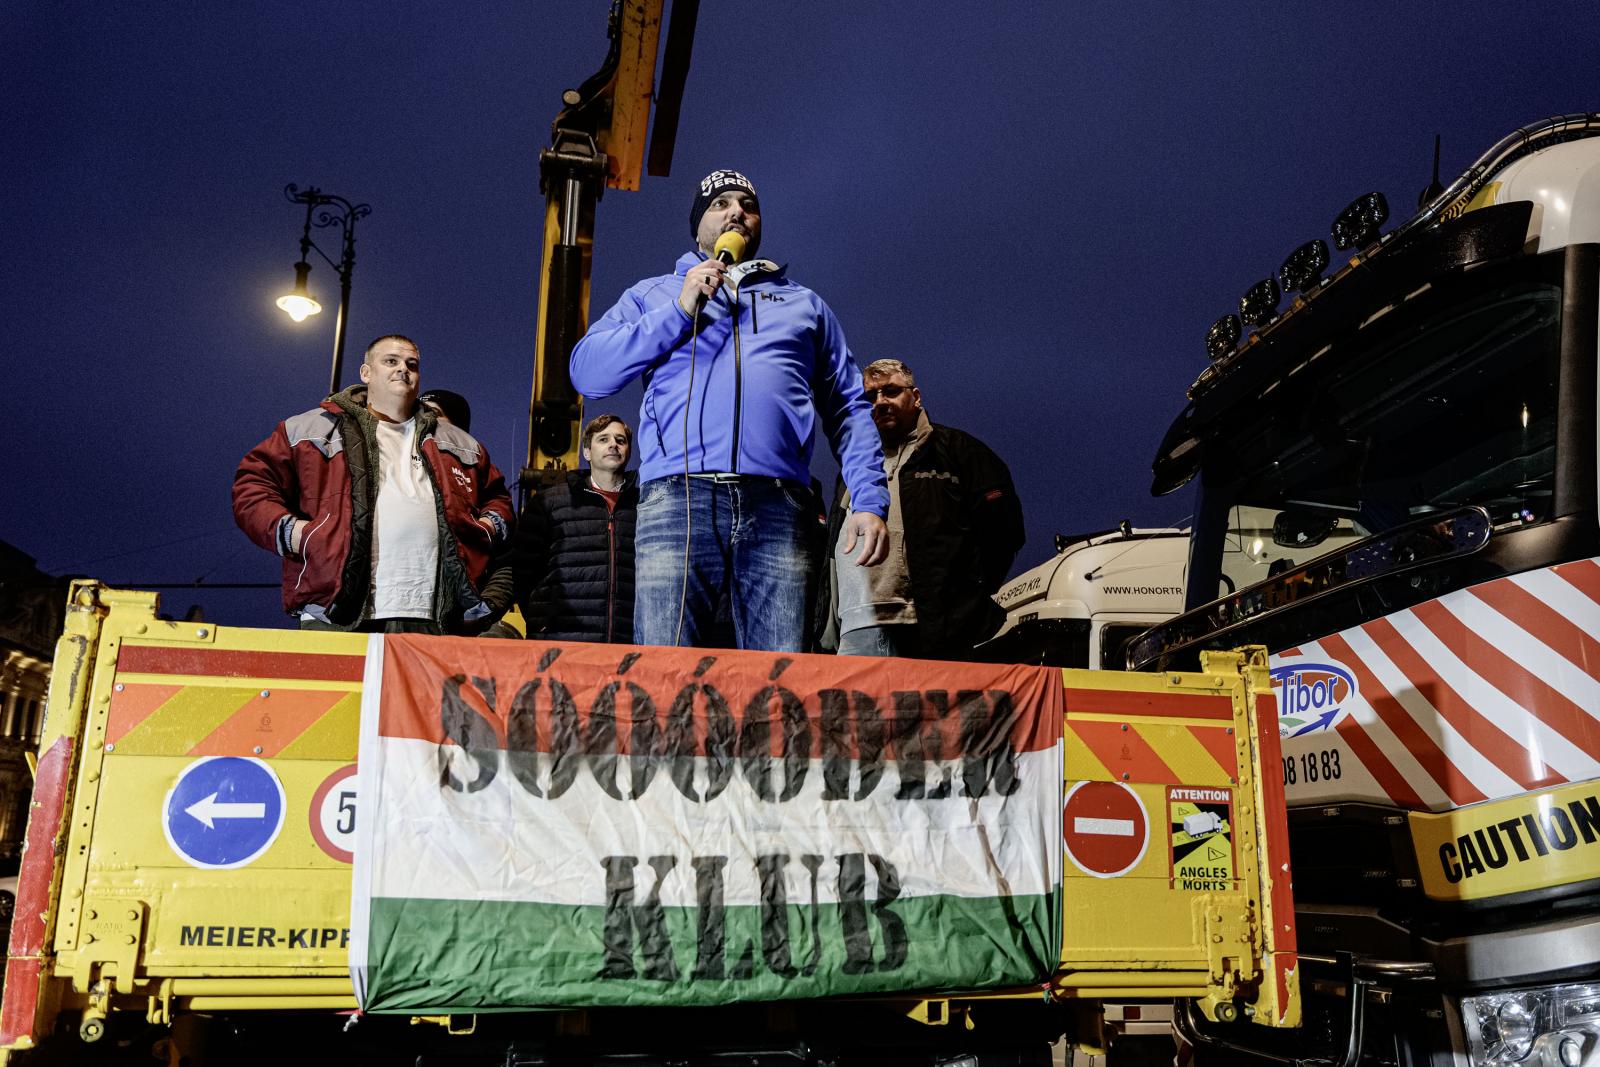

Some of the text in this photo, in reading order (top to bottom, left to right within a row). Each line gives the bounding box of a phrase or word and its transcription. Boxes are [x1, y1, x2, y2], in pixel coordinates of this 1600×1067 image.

[1276, 671, 1338, 715] Tibor
[1301, 752, 1319, 783] 18
[1321, 749, 1342, 781] 83
[1170, 788, 1230, 801] ATTENTION
[1438, 796, 1600, 884] CAUTION
[1180, 867, 1228, 878] ANGLES
[1183, 880, 1227, 891] MORTS
[596, 852, 909, 981] KLUB
